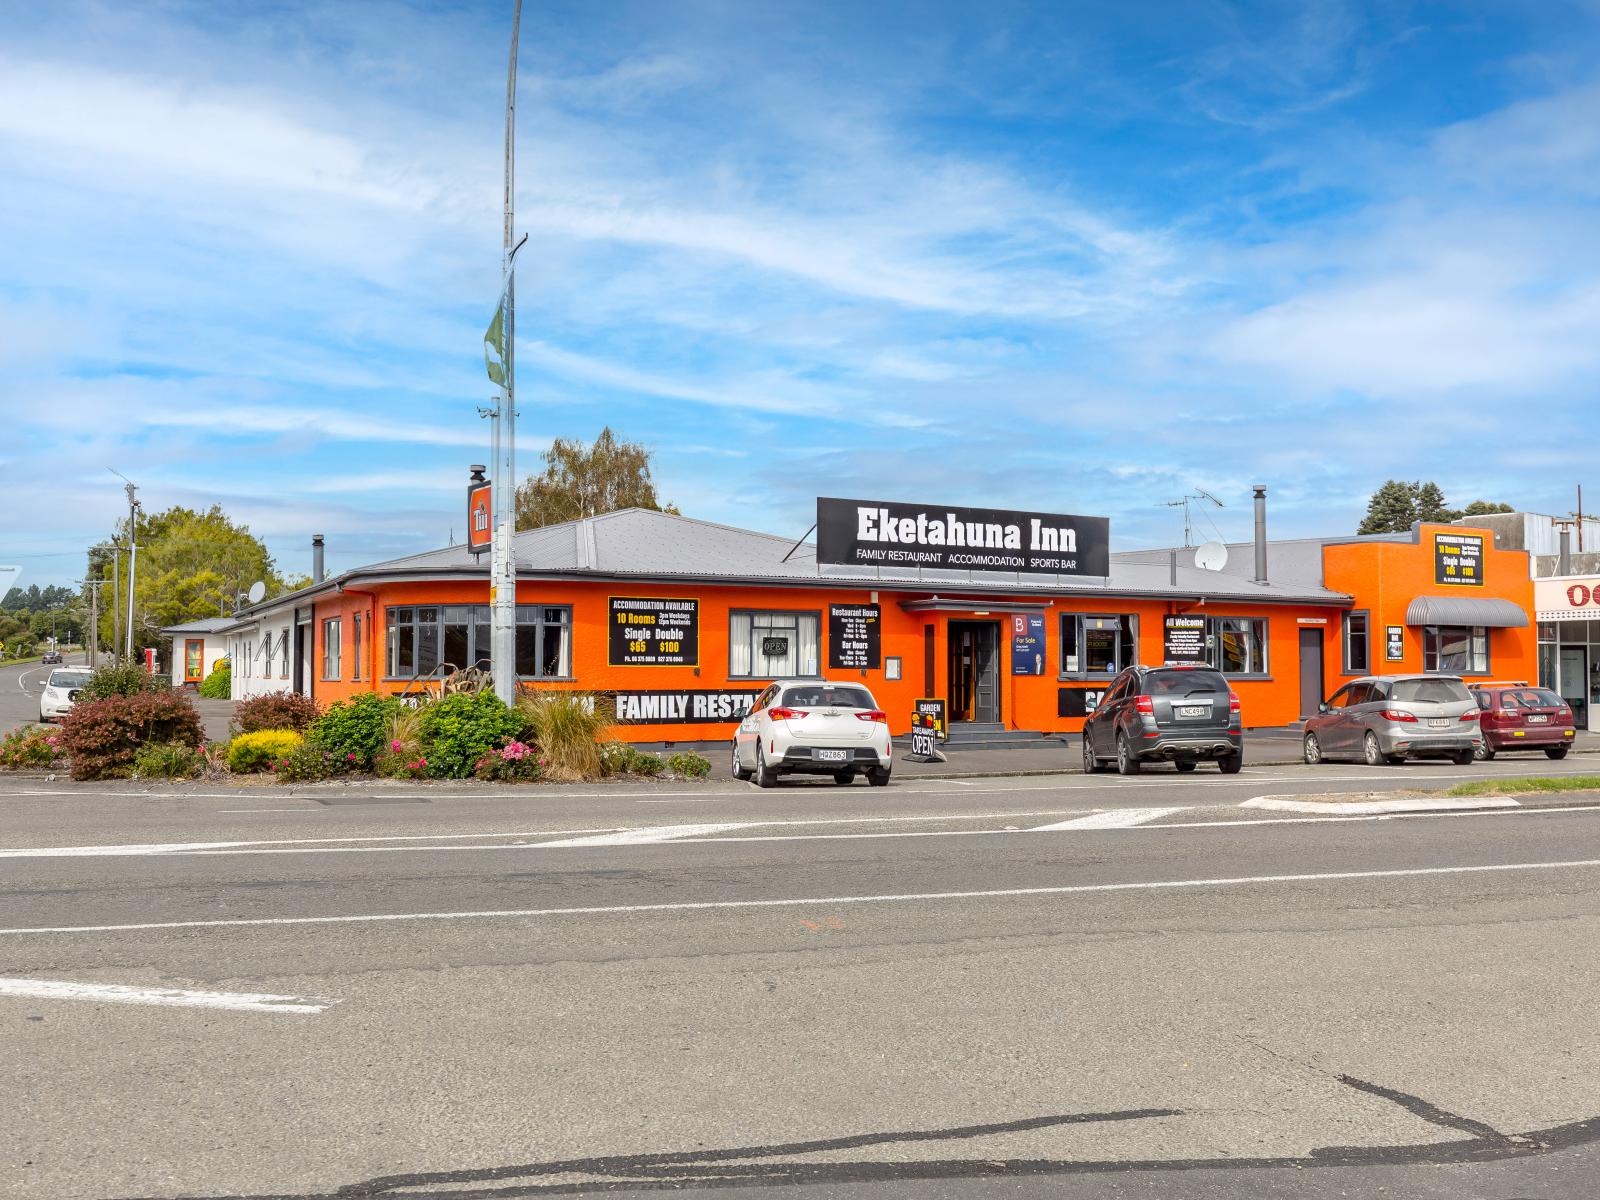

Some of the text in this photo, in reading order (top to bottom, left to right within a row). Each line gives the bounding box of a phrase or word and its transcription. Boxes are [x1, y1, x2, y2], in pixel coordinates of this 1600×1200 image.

[857, 507, 1076, 552] Eketahuna Inn
[856, 549, 1076, 569] FAMILY RESTAURANT ACCOMMODATION SPORTS BAR
[614, 600, 695, 610] ACCOMMODATION AVAILABLE
[832, 608, 878, 617] Restaurant Hours
[617, 613, 655, 624] 10 Rooms
[1166, 618, 1204, 626] All Welcome
[625, 628, 683, 641] Single Double
[630, 641, 679, 652] $65 $100
[764, 642, 787, 650] OPEN
[616, 695, 689, 718] FAMILY
[693, 695, 758, 718] RESTA
[912, 735, 933, 756] OPEN
